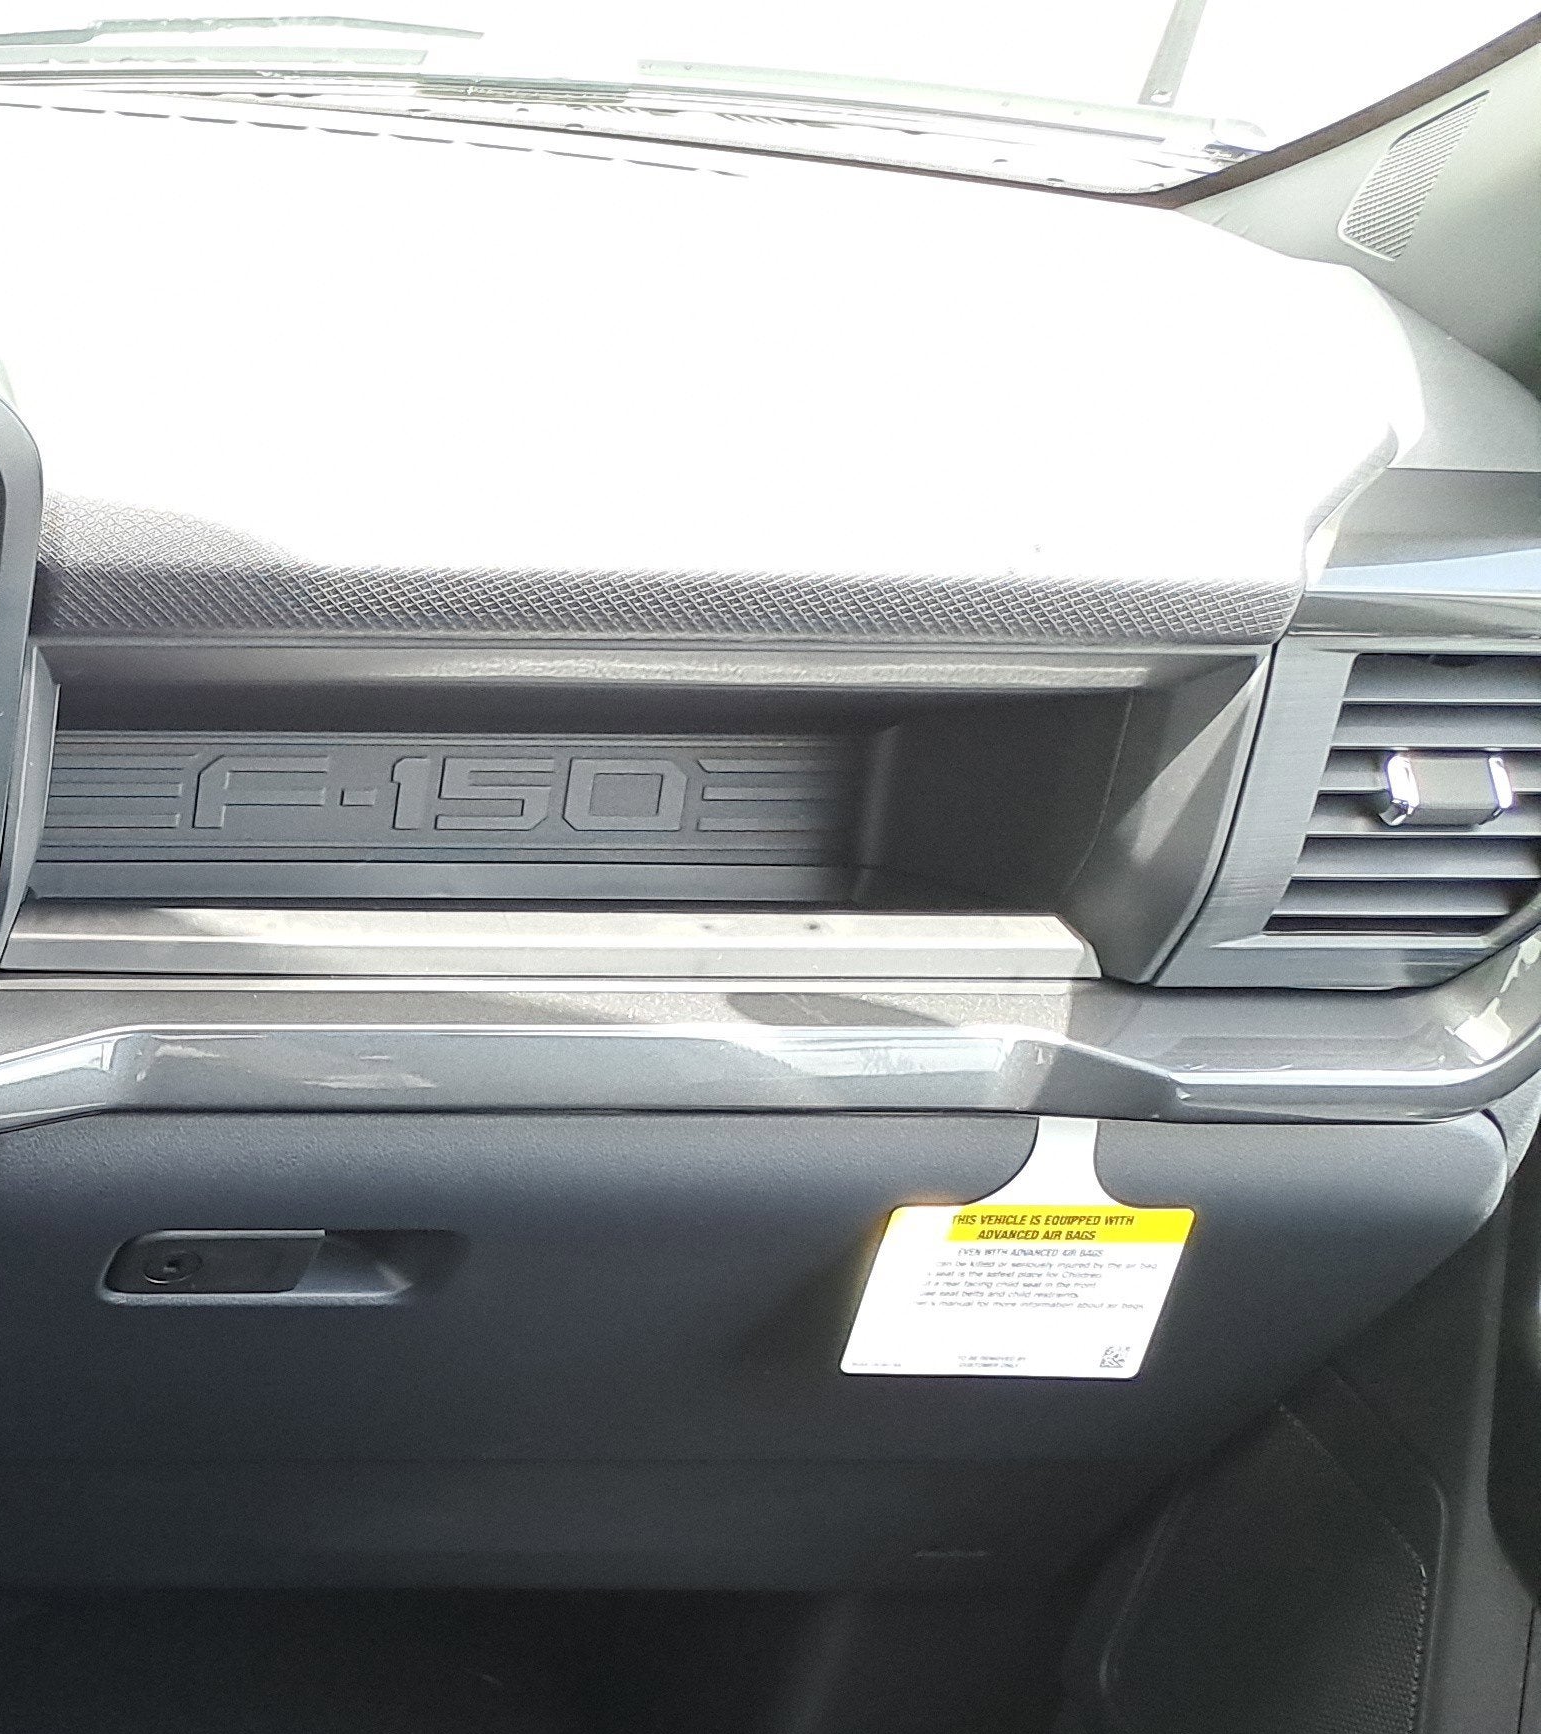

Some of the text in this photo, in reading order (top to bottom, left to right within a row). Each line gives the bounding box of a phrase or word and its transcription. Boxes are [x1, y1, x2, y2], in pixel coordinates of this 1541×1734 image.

[190, 753, 689, 833] F-150
[952, 1214, 1135, 1226] THIS VEHICLE IS EQUIPPED WITH
[977, 1229, 1097, 1241] ADVANCED AIR BAGS
